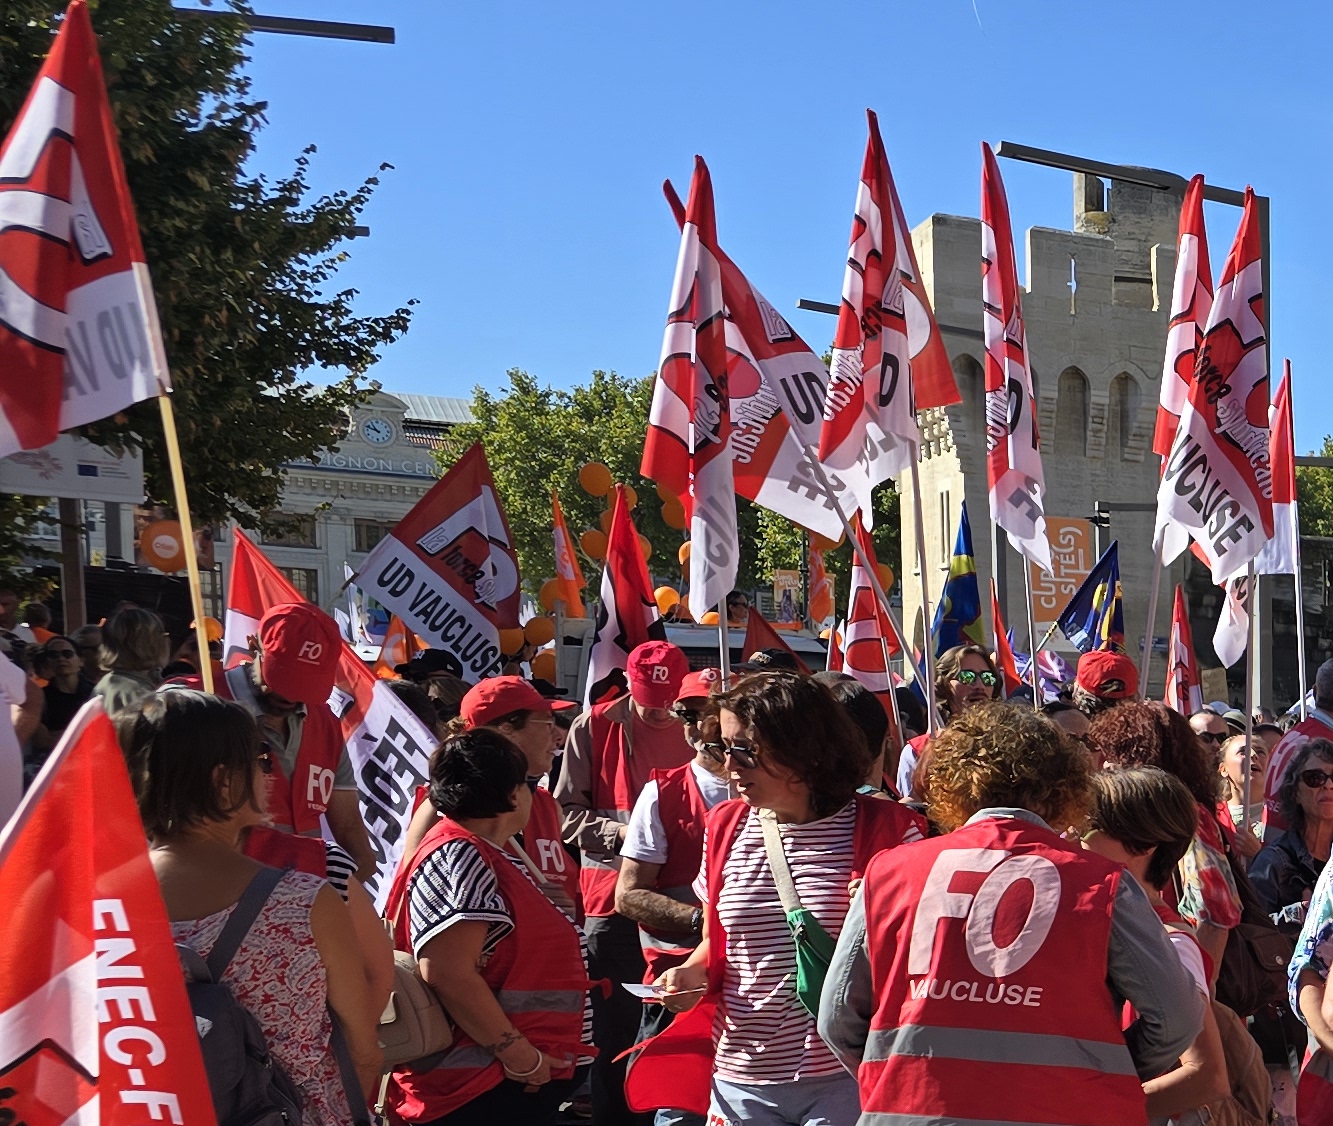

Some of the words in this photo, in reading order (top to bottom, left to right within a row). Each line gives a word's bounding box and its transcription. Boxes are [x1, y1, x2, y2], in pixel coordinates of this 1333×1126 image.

[316, 453, 393, 471] VIGNON
[376, 556, 416, 598] UD
[299, 640, 322, 660] FO
[652, 665, 669, 681] FO
[306, 764, 336, 805] FO
[536, 838, 566, 873] FO
[907, 848, 1062, 978] FO
[909, 979, 1044, 1008] VAUCLUSE
